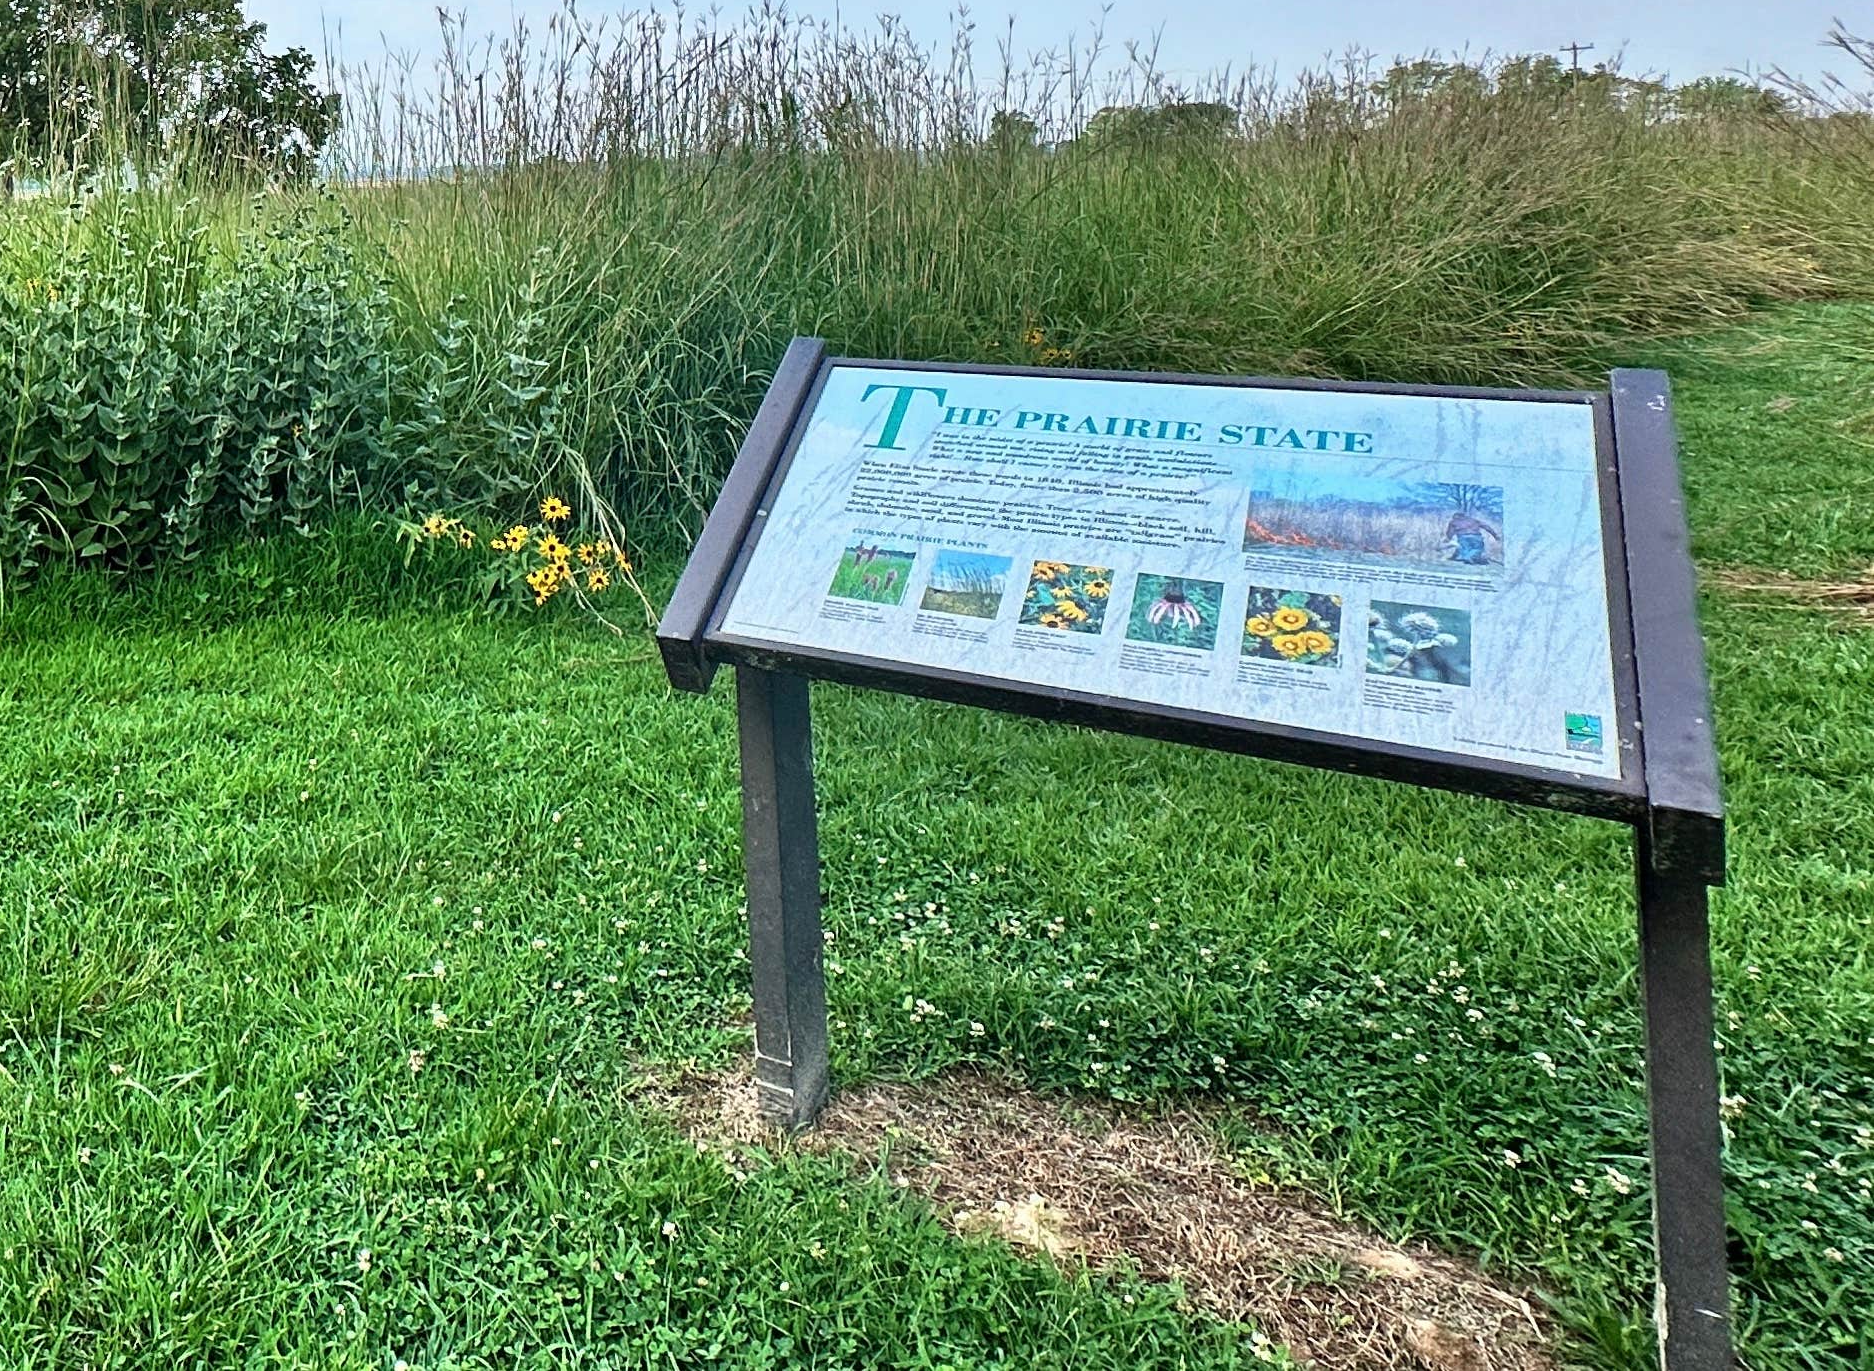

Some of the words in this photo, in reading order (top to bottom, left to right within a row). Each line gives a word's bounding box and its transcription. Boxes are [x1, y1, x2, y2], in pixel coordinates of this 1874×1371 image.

[861, 384, 1000, 451] THE
[1014, 411, 1203, 442] PRAIRIE
[1218, 423, 1374, 454] STATE
